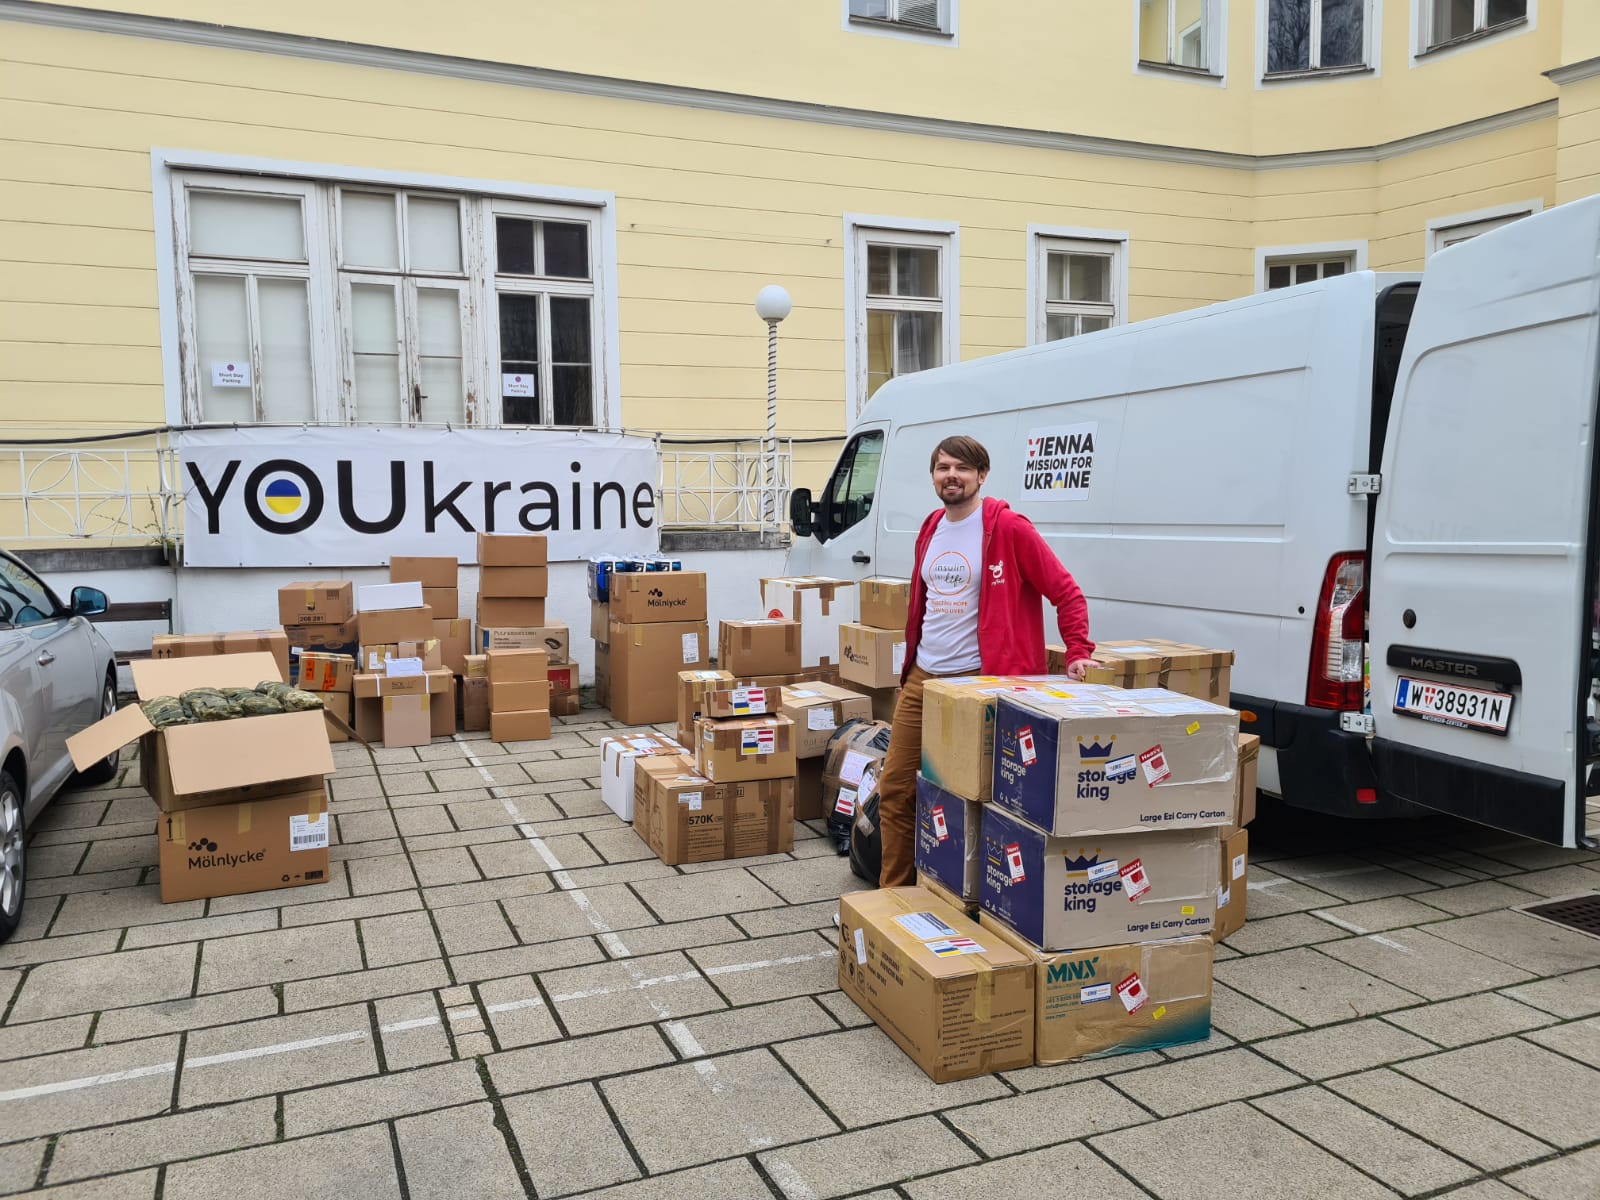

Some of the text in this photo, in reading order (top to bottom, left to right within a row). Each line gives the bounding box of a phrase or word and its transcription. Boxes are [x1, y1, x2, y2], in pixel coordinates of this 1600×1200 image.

[1028, 432, 1094, 457] VIENNA
[1026, 456, 1093, 472] MISSION FOR
[1024, 470, 1091, 490] UKRAINE
[185, 458, 656, 536] YOUkraine
[935, 563, 965, 572] insulin
[1410, 656, 1480, 676] MASTER
[1411, 684, 1424, 707] W
[1434, 689, 1503, 723] 38931N
[1141, 747, 1161, 761] Heavy
[1001, 756, 1027, 776] storage
[1077, 783, 1110, 801] king
[1140, 814, 1162, 823] Large
[1176, 811, 1198, 820] Carry
[1199, 810, 1226, 819] Carton
[188, 850, 266, 870] Mölnlycke
[1120, 861, 1141, 875] Heavy
[986, 872, 1001, 894] king
[987, 864, 1013, 887] storage
[1064, 880, 1122, 896] storage
[1064, 895, 1097, 913] king
[1127, 923, 1149, 932] Large
[1162, 919, 1183, 928] Carry
[1184, 917, 1210, 926] Carton
[1047, 956, 1099, 984] MNX
[1117, 975, 1138, 991] Heavy
